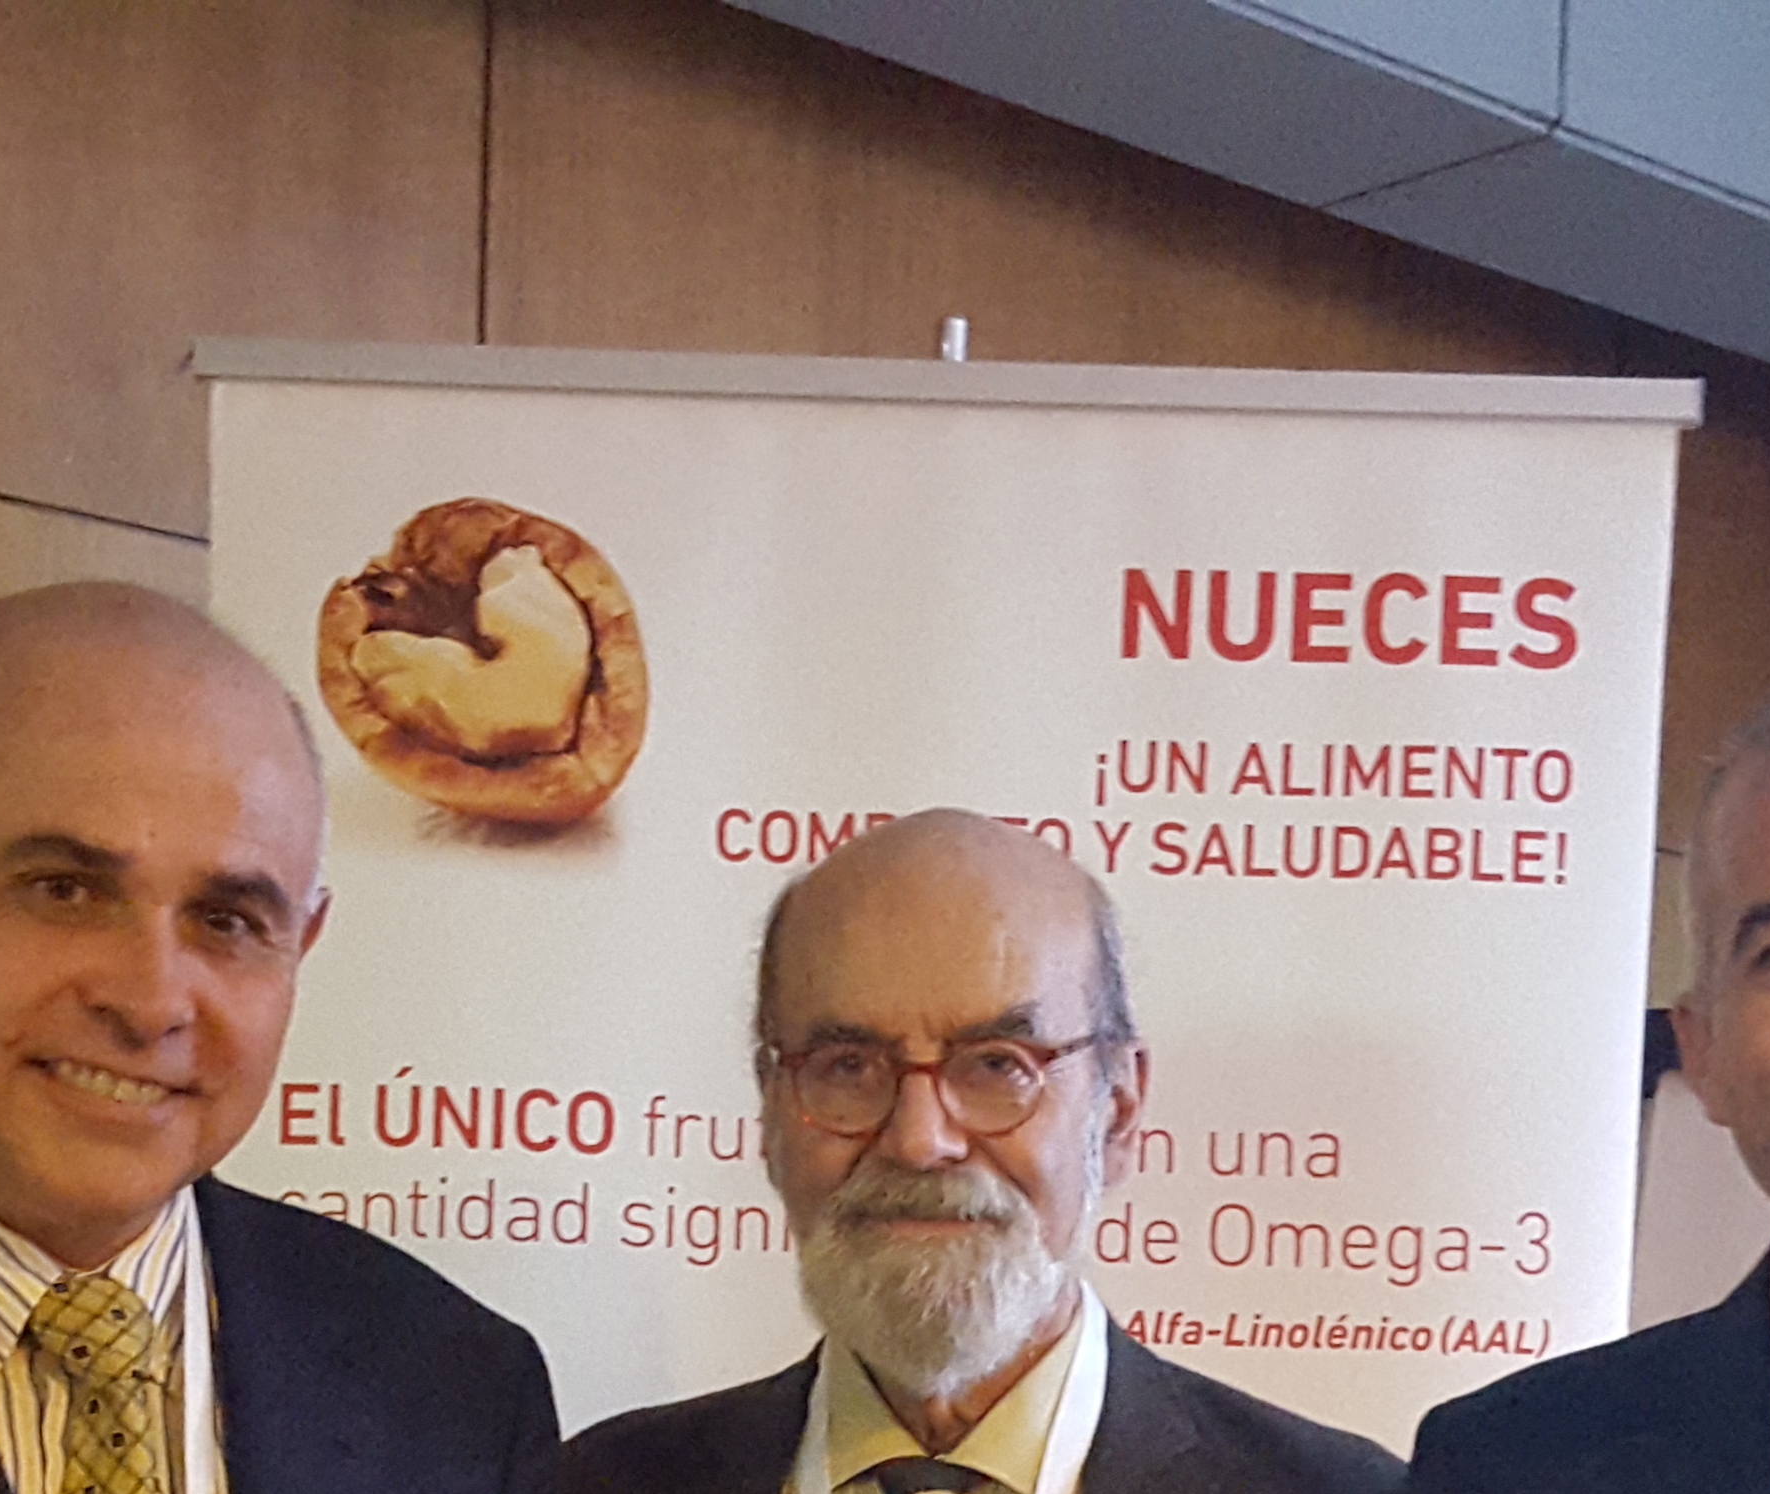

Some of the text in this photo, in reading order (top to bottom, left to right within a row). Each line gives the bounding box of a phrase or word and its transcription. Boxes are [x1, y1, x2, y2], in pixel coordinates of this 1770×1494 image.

[1120, 567, 1579, 671] NUECES
[1096, 739, 1574, 806] ¡UN ALIMENTO
[716, 808, 1570, 885] COMO Y SALUDABLE!
[279, 1082, 347, 1146] El
[374, 1065, 617, 1155] ÚNICO
[644, 1095, 767, 1164] fru
[1208, 1129, 1341, 1179] una
[280, 1178, 591, 1245] antidad
[1095, 1201, 1180, 1265] de
[1209, 1202, 1552, 1288] Omega-3
[1440, 1315, 1551, 1358] (AAL)
